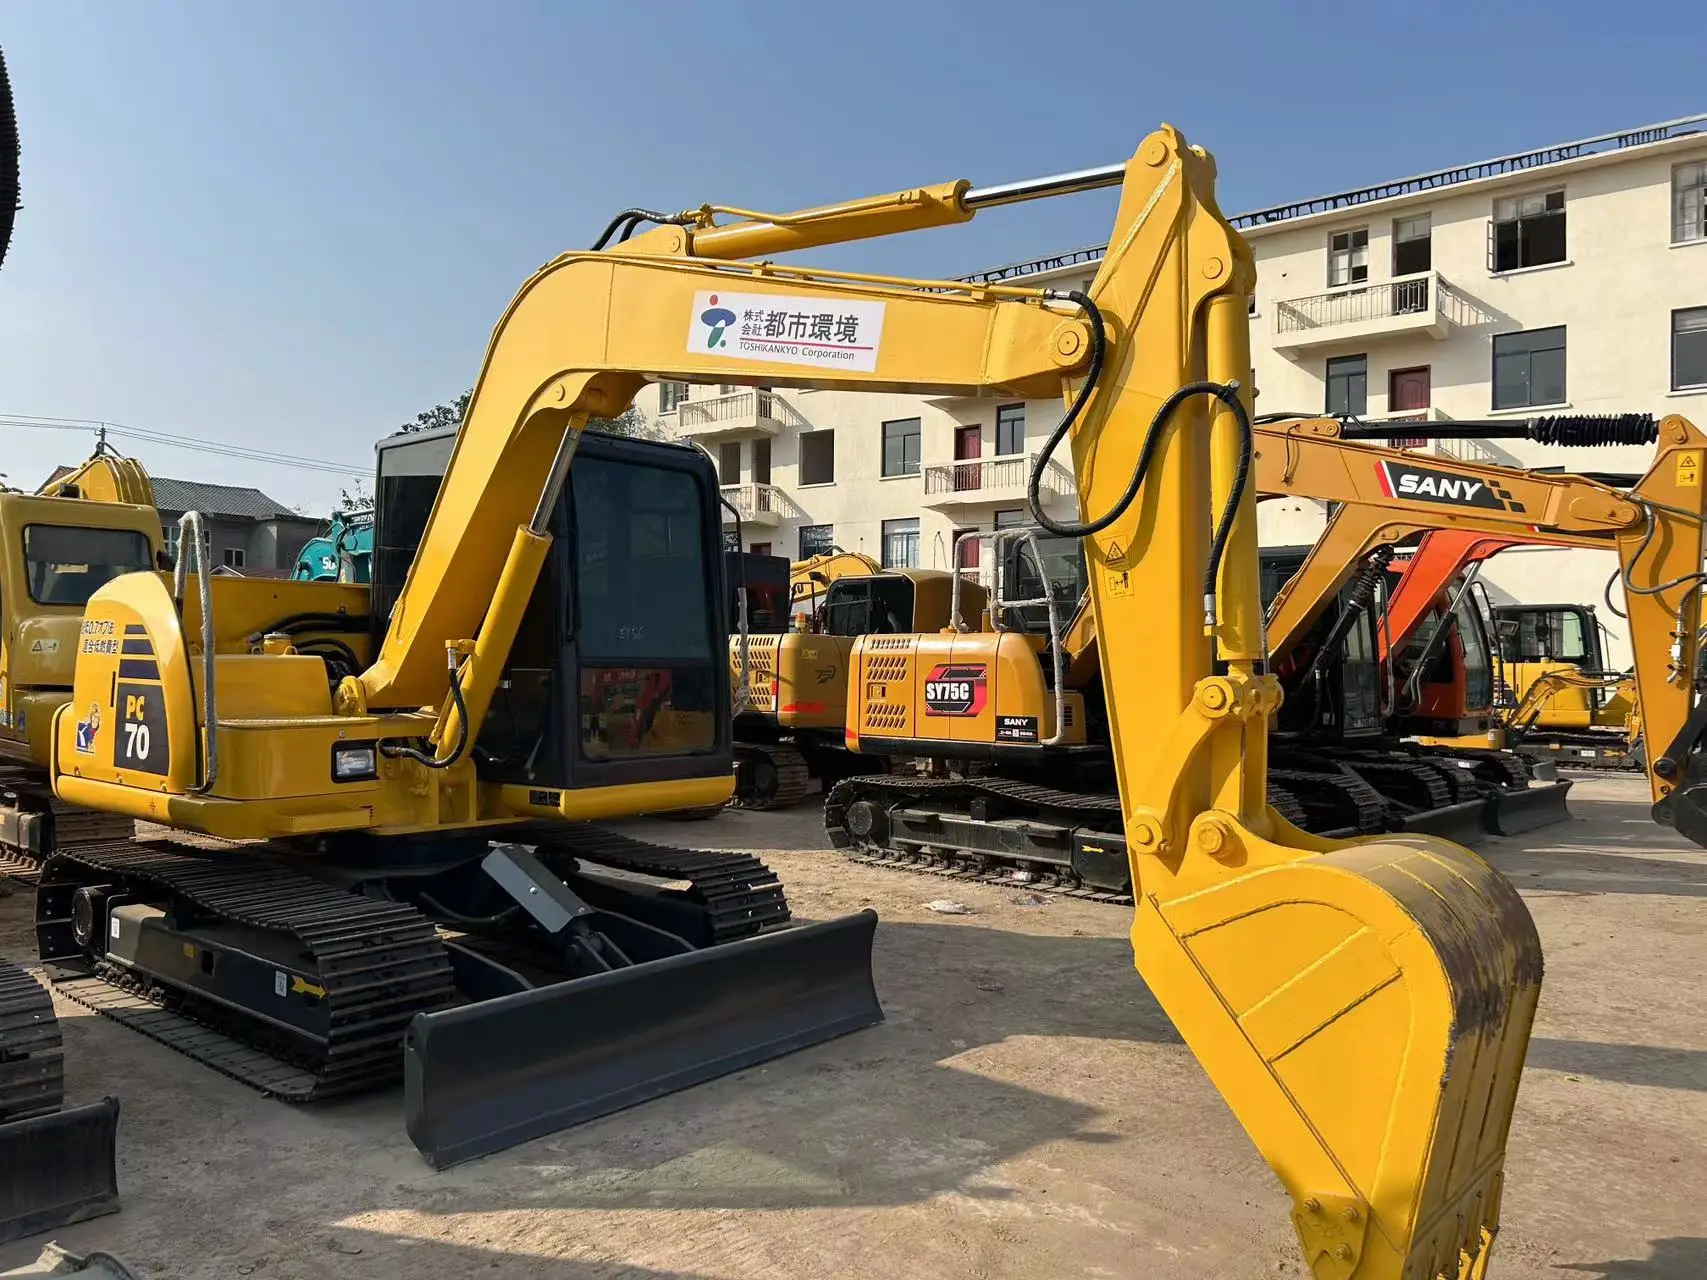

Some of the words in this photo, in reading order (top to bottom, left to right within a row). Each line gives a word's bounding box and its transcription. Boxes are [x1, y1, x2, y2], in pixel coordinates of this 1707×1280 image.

[743, 309, 765, 322] 株式
[741, 322, 763, 336] 会社
[763, 310, 859, 343] 都市環境
[739, 341, 798, 355] TOSHIKANKYO
[801, 346, 855, 360] Corporation
[1398, 474, 1482, 501] SANY
[926, 682, 970, 700] SY75C
[125, 694, 145, 721] PC
[1003, 718, 1028, 726] SANY
[125, 722, 150, 760] 70
